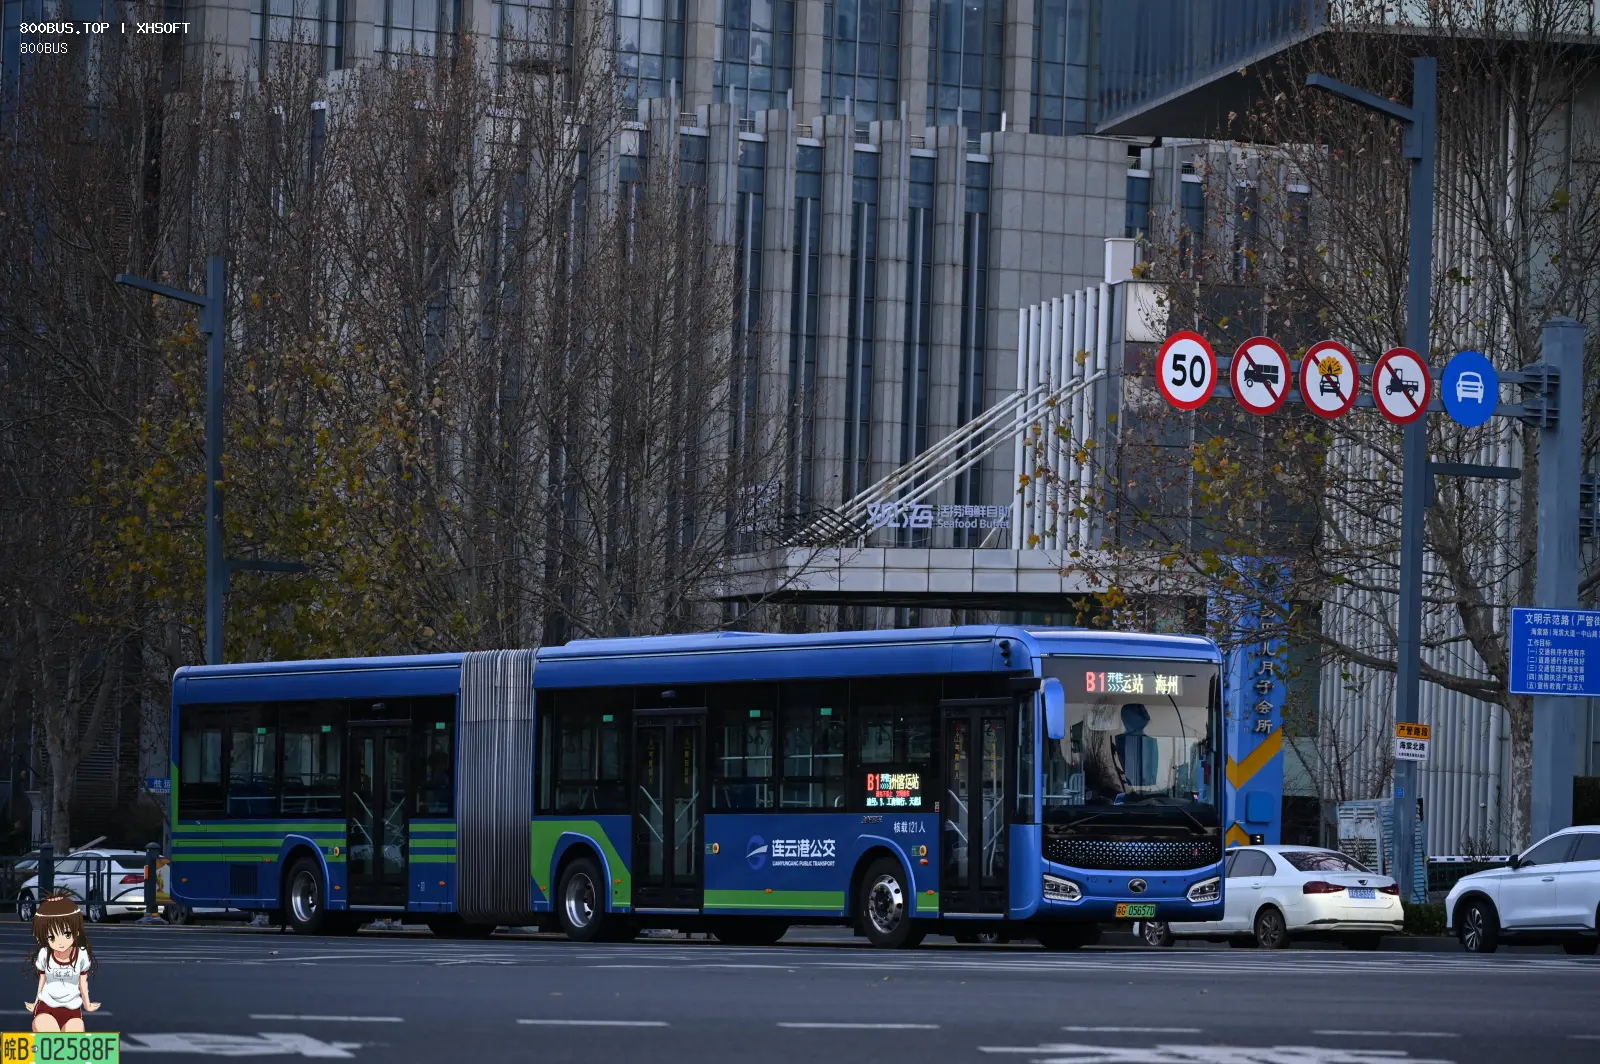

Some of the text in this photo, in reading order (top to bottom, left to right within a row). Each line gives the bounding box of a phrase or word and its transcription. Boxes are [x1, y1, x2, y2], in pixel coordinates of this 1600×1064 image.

[1171, 353, 1206, 388] 50
[866, 502, 934, 529] 观海
[937, 504, 1011, 518] 活捞海鲜自助
[937, 518, 978, 529] Seafood
[1086, 671, 1105, 692] B1
[1107, 672, 1124, 683] 开往
[1155, 674, 1179, 695] 海州
[1399, 741, 1425, 751] 海棠北路
[867, 773, 880, 791] B1
[771, 838, 836, 858] 连云港公交
